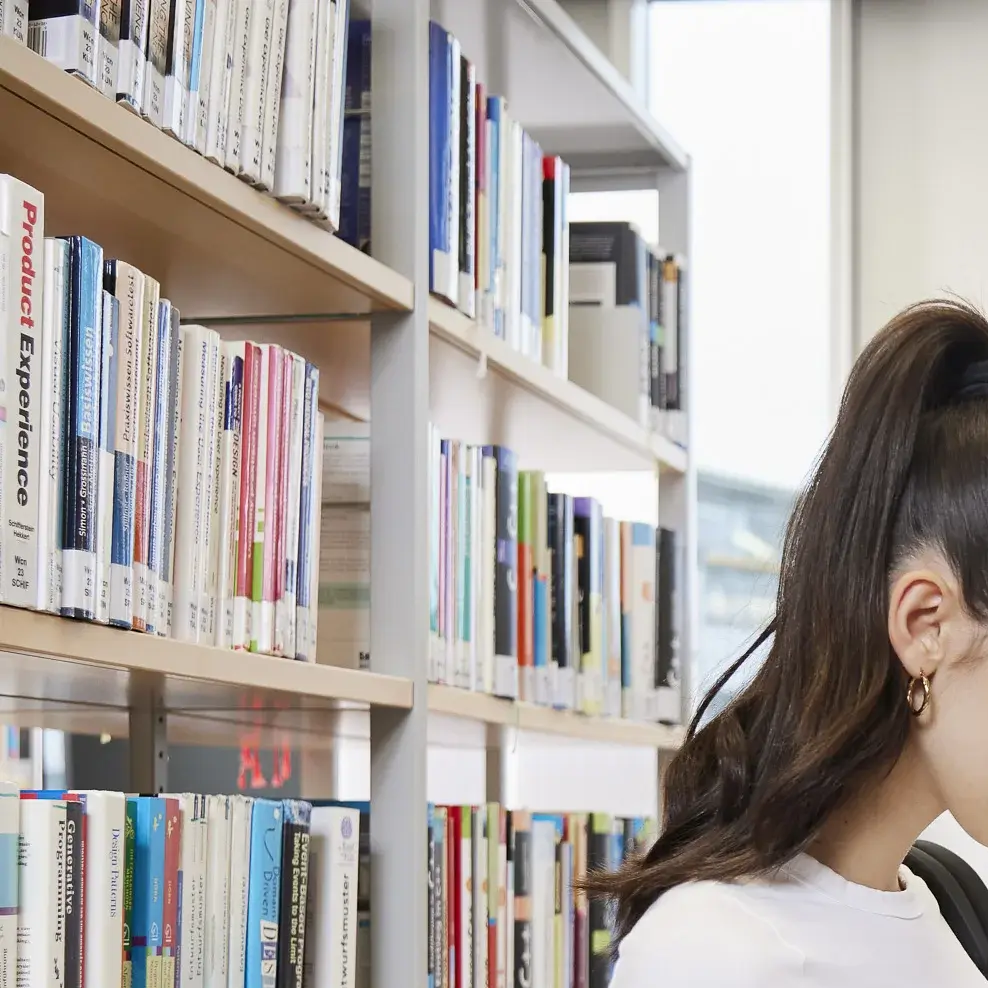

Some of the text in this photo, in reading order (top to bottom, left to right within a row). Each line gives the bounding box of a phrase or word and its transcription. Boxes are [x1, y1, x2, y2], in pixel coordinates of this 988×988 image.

[16, 200, 38, 507] Product Experience
[80, 326, 94, 434] Basiswissen
[122, 275, 135, 442] Praxiswissen Softwaretest
[198, 341, 207, 409] Measuring
[217, 354, 226, 408] Measuring
[213, 460, 221, 513] Experience
[231, 434, 239, 477] DESIGN
[79, 444, 88, 537] Simon Grossmann
[11, 578, 30, 590] SCHIF
[17, 568, 24, 577] 23
[54, 819, 66, 943] Programming
[66, 819, 76, 914] Generative
[109, 828, 121, 918] Design Patterns
[291, 832, 300, 865] Taking
[291, 867, 299, 902] Events
[298, 833, 309, 934] Event-Based
[289, 938, 297, 964] Limit
